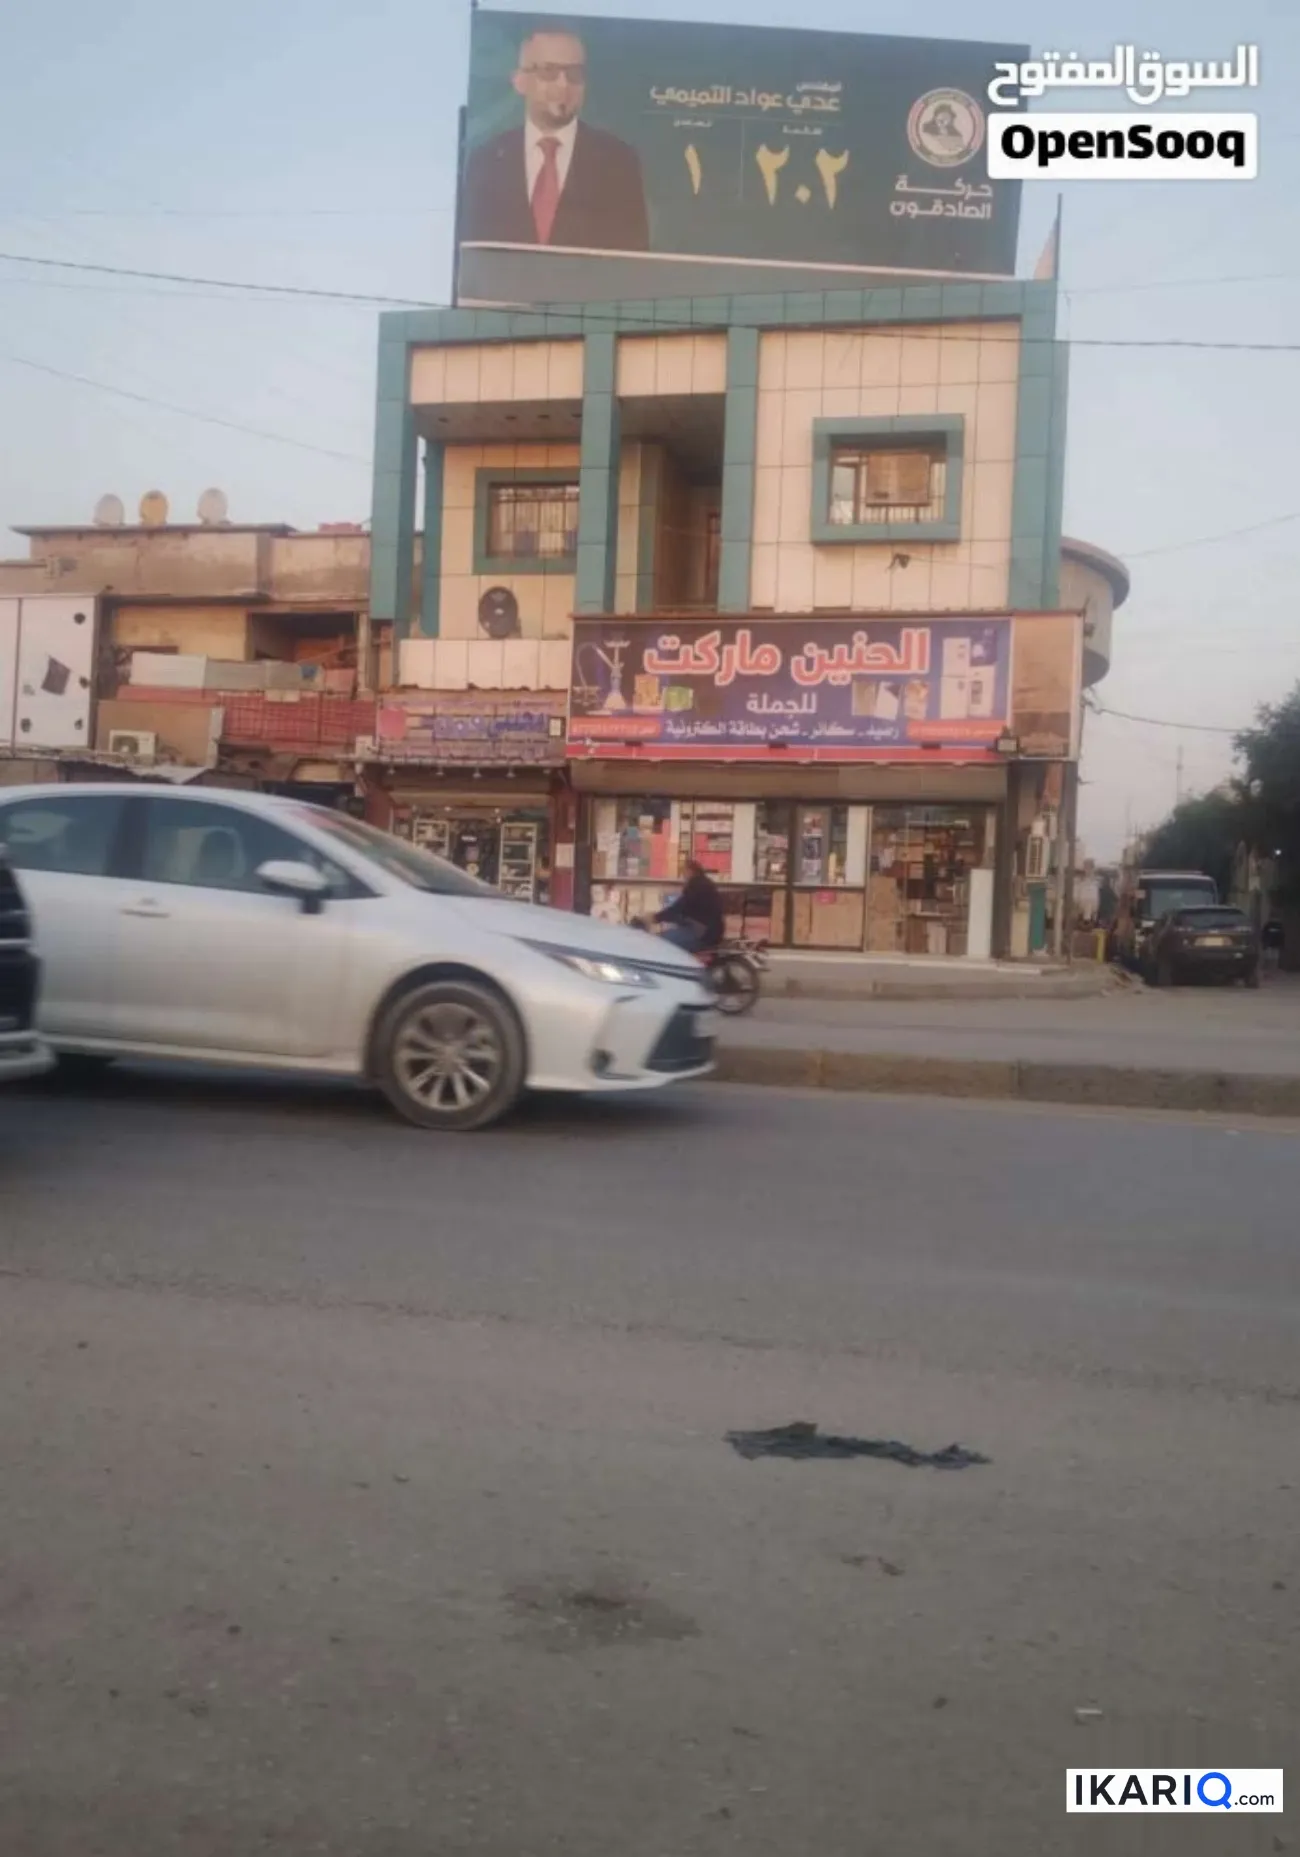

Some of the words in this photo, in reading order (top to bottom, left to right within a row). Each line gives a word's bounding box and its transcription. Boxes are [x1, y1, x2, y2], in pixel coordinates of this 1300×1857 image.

[650, 85, 732, 108] التميمي
[734, 87, 783, 111] عواد
[786, 93, 841, 115] عدي
[683, 143, 702, 195] ١
[755, 143, 850, 210] ٢٠٢
[894, 174, 993, 200] حركة
[889, 198, 992, 219] الصادقون
[643, 629, 782, 686] ماركت
[790, 627, 931, 686] الحنين
[746, 691, 817, 718] للجملة
